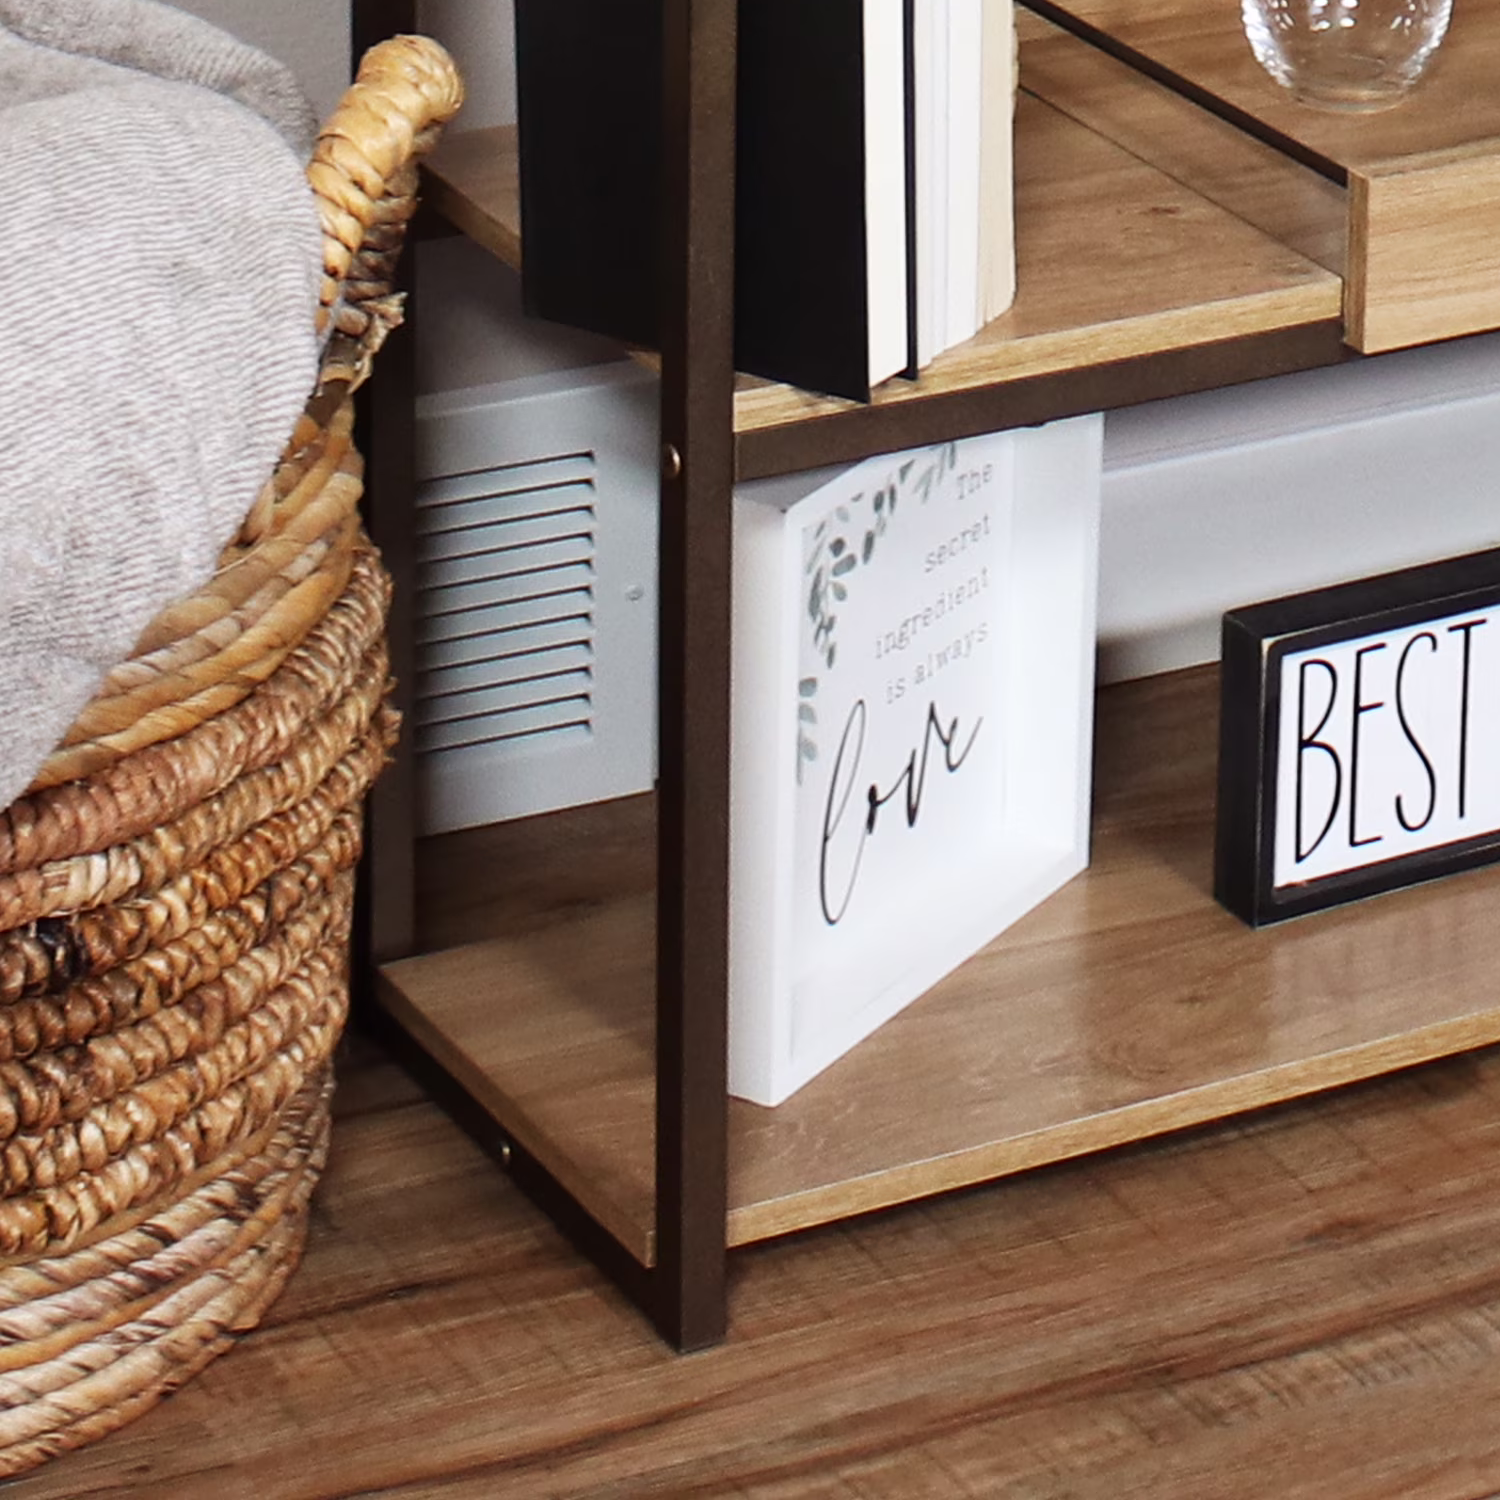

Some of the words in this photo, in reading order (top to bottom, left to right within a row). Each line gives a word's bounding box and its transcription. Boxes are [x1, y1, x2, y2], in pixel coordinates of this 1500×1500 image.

[956, 463, 993, 500] The
[924, 514, 991, 573] secret
[874, 567, 990, 660] ingredient
[886, 677, 906, 704] is
[913, 622, 989, 685] always
[1294, 619, 1488, 864] BEST
[819, 698, 984, 925] love
